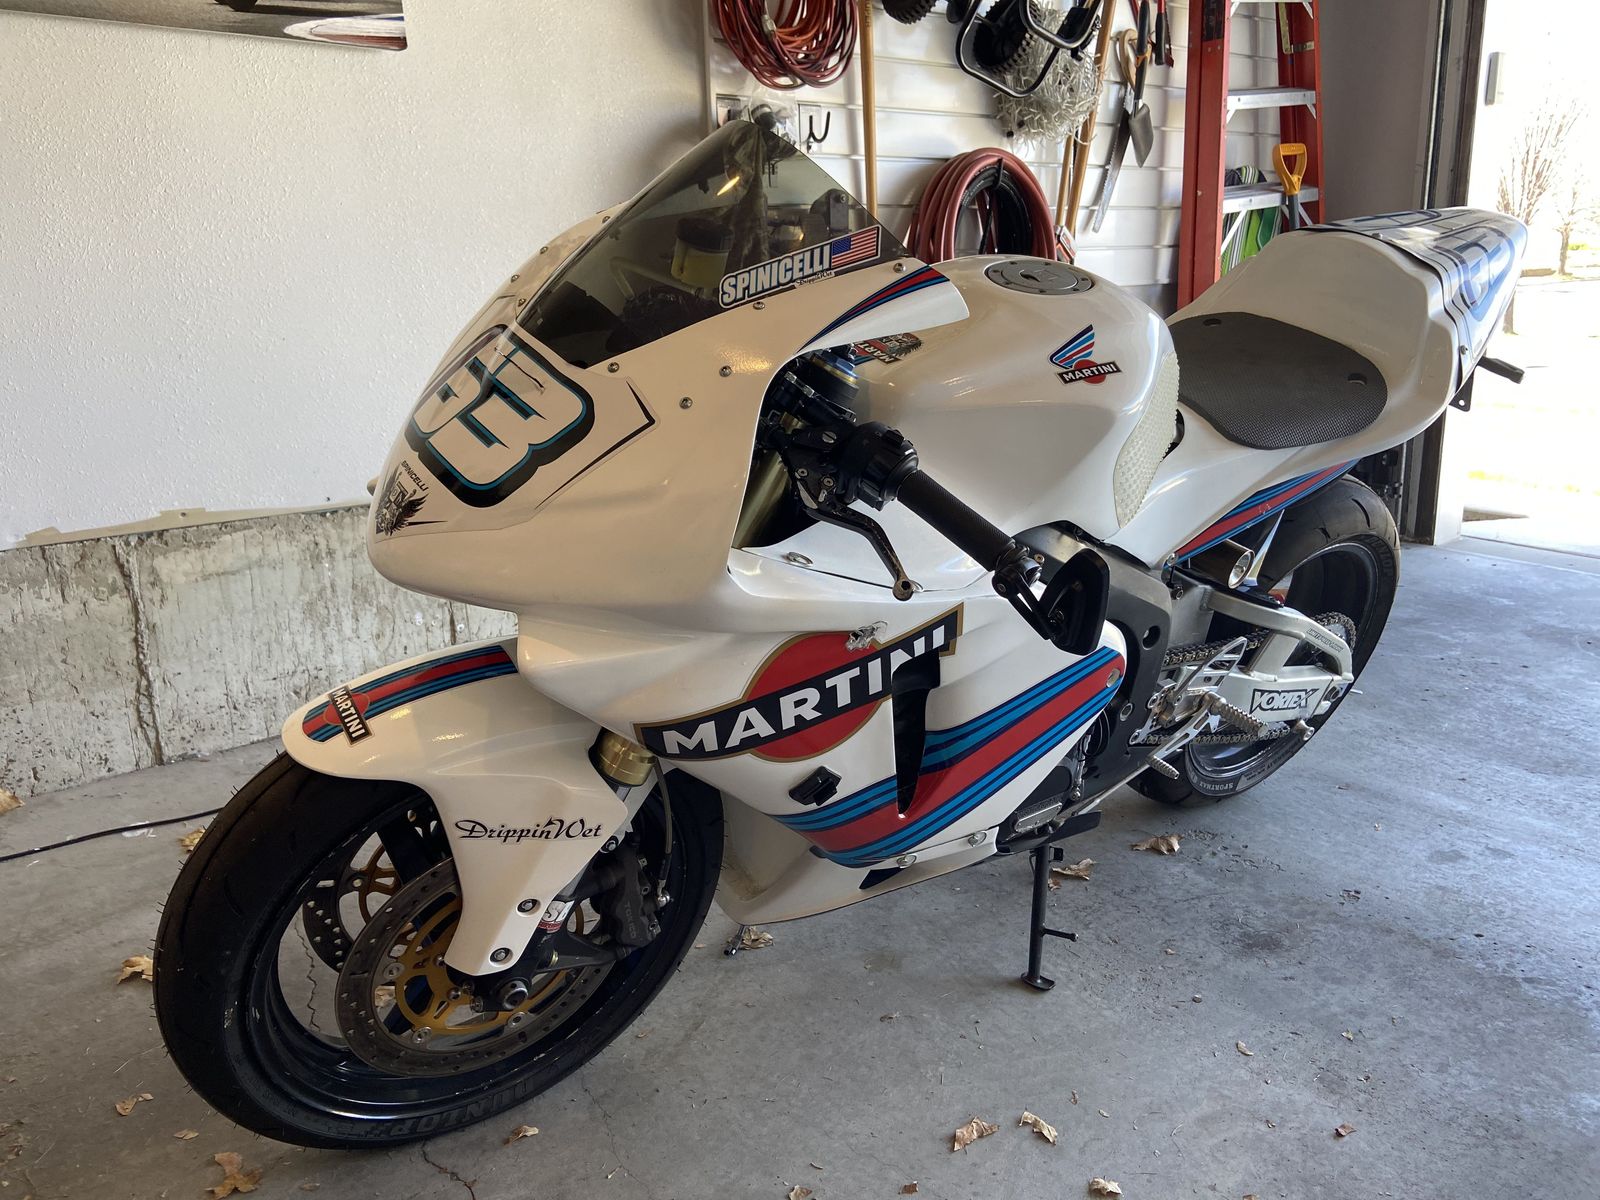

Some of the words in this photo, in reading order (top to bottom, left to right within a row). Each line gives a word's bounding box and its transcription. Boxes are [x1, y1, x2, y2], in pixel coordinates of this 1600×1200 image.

[722, 243, 831, 305] SPINICELLI
[1061, 362, 1119, 383] MARTINI
[400, 460, 429, 492] SPINICELLI
[331, 687, 366, 739] MARTINI
[1250, 688, 1319, 713] VORTEX
